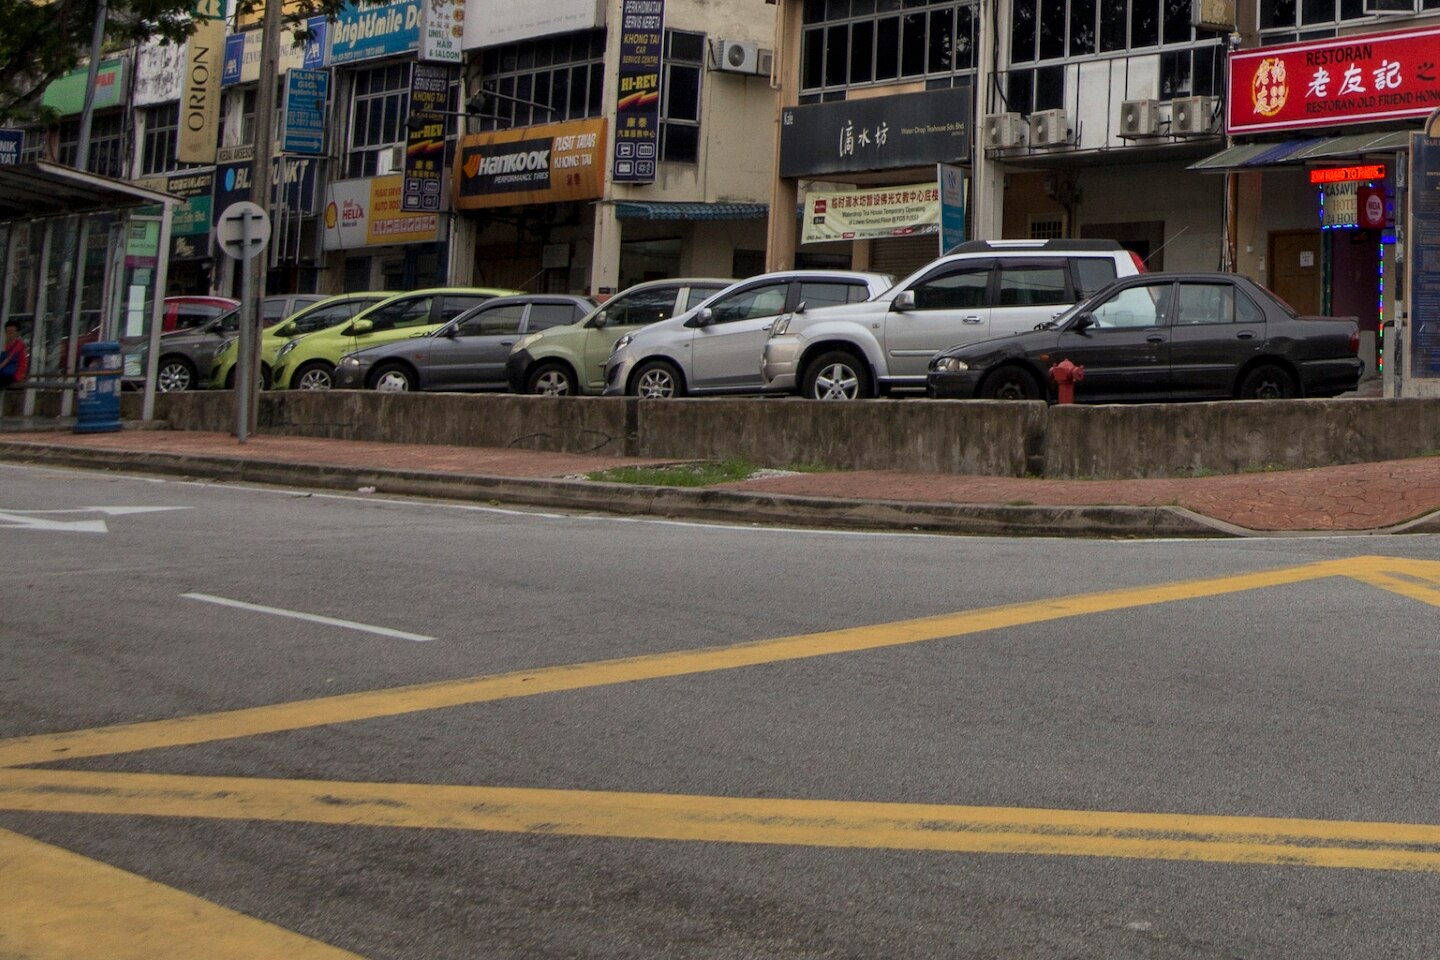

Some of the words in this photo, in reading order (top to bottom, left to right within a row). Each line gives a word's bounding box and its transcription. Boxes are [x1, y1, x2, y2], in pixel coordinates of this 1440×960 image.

[624, 15, 642, 29] SERVIS
[641, 16, 661, 30] KERETA
[436, 40, 453, 50] HAIR
[623, 33, 648, 45] KHONG
[648, 34, 660, 45] TAI
[635, 45, 647, 55] CAR
[1305, 44, 1373, 67] RESTORAN
[188, 46, 209, 132] ORION
[621, 73, 658, 91] HI-REV
[412, 91, 435, 103] KHONG
[1305, 96, 1355, 114] RESTORAN
[1357, 95, 1377, 108] OLD
[1378, 91, 1413, 107] FRIEND
[914, 126, 926, 135] Drop
[554, 135, 576, 152] PUSAT
[554, 155, 580, 169] KHONG
[581, 153, 592, 166] TAI
[235, 159, 309, 190] BLUNKT
[1333, 198, 1357, 212] HOTE
[342, 207, 365, 220] HELIX
[1337, 212, 1357, 224] HOU
